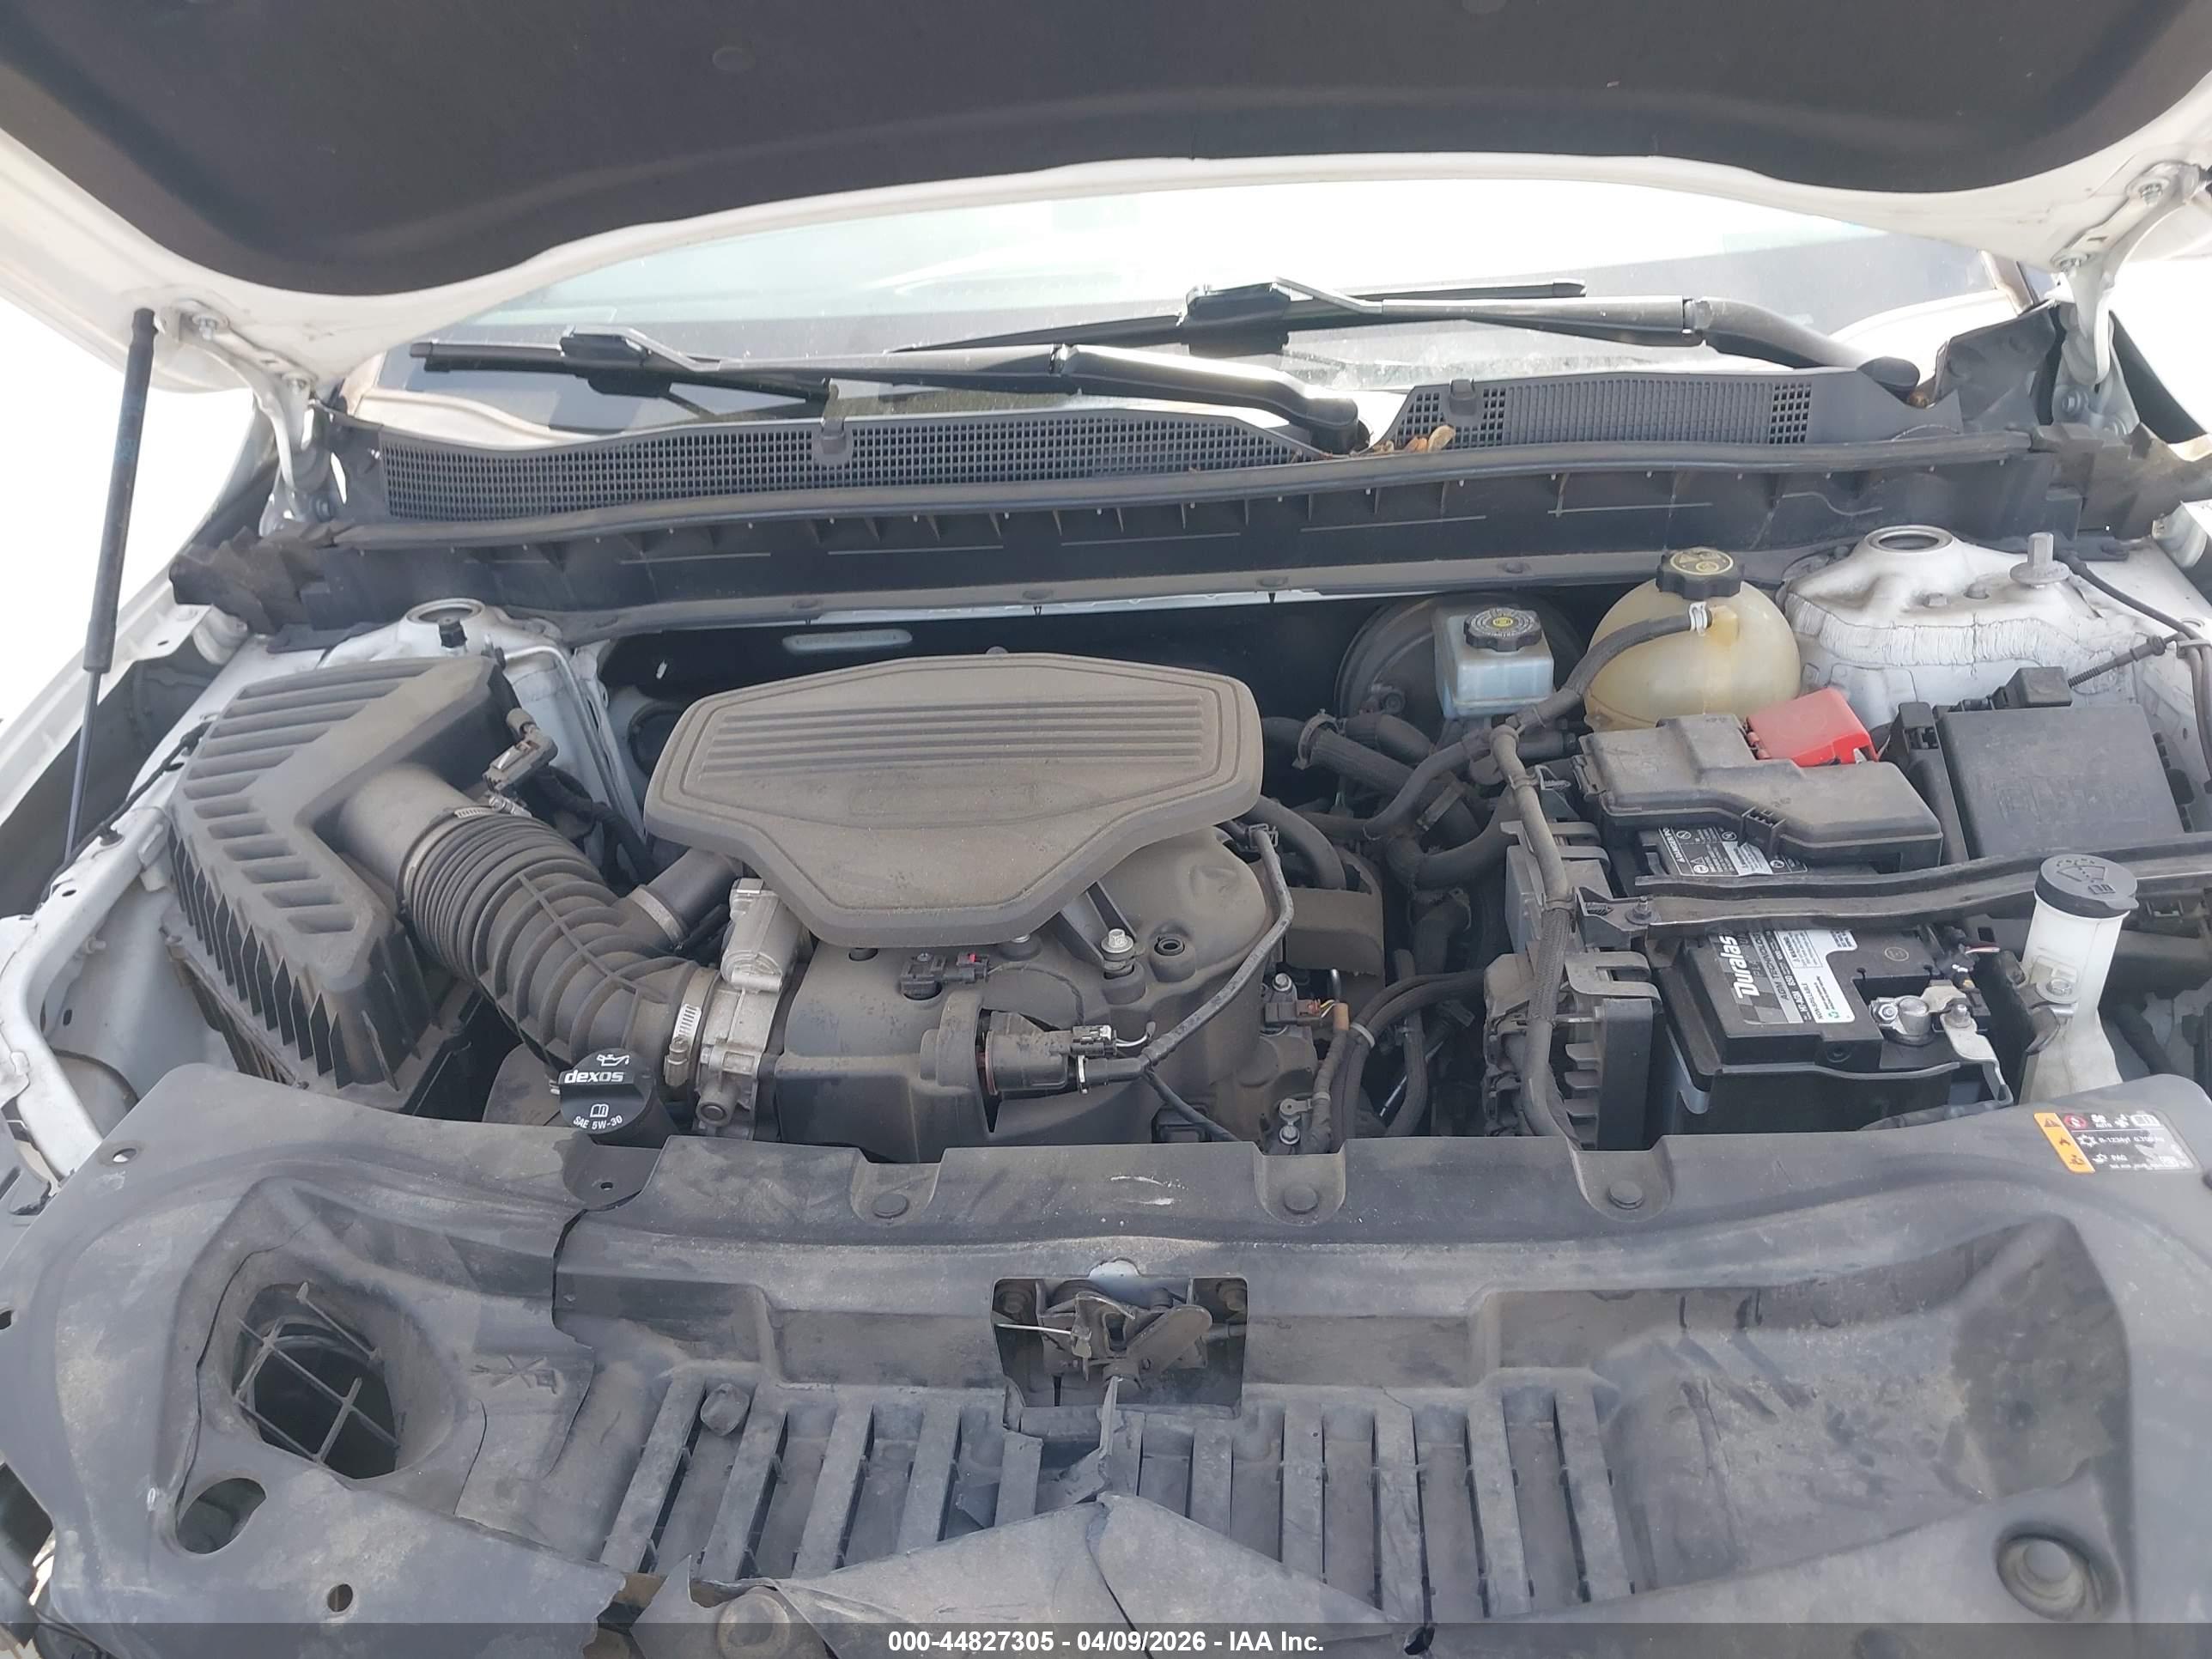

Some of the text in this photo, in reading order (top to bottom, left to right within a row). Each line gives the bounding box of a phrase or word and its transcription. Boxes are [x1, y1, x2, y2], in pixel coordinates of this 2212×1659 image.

[1752, 933, 1780, 979] TECHNOLOG
[1718, 935, 1760, 1000] Duralas
[1773, 981, 1790, 1000] AGM
[564, 1069, 625, 1083] dexos
[573, 1115, 623, 1130] SAE 5W-30
